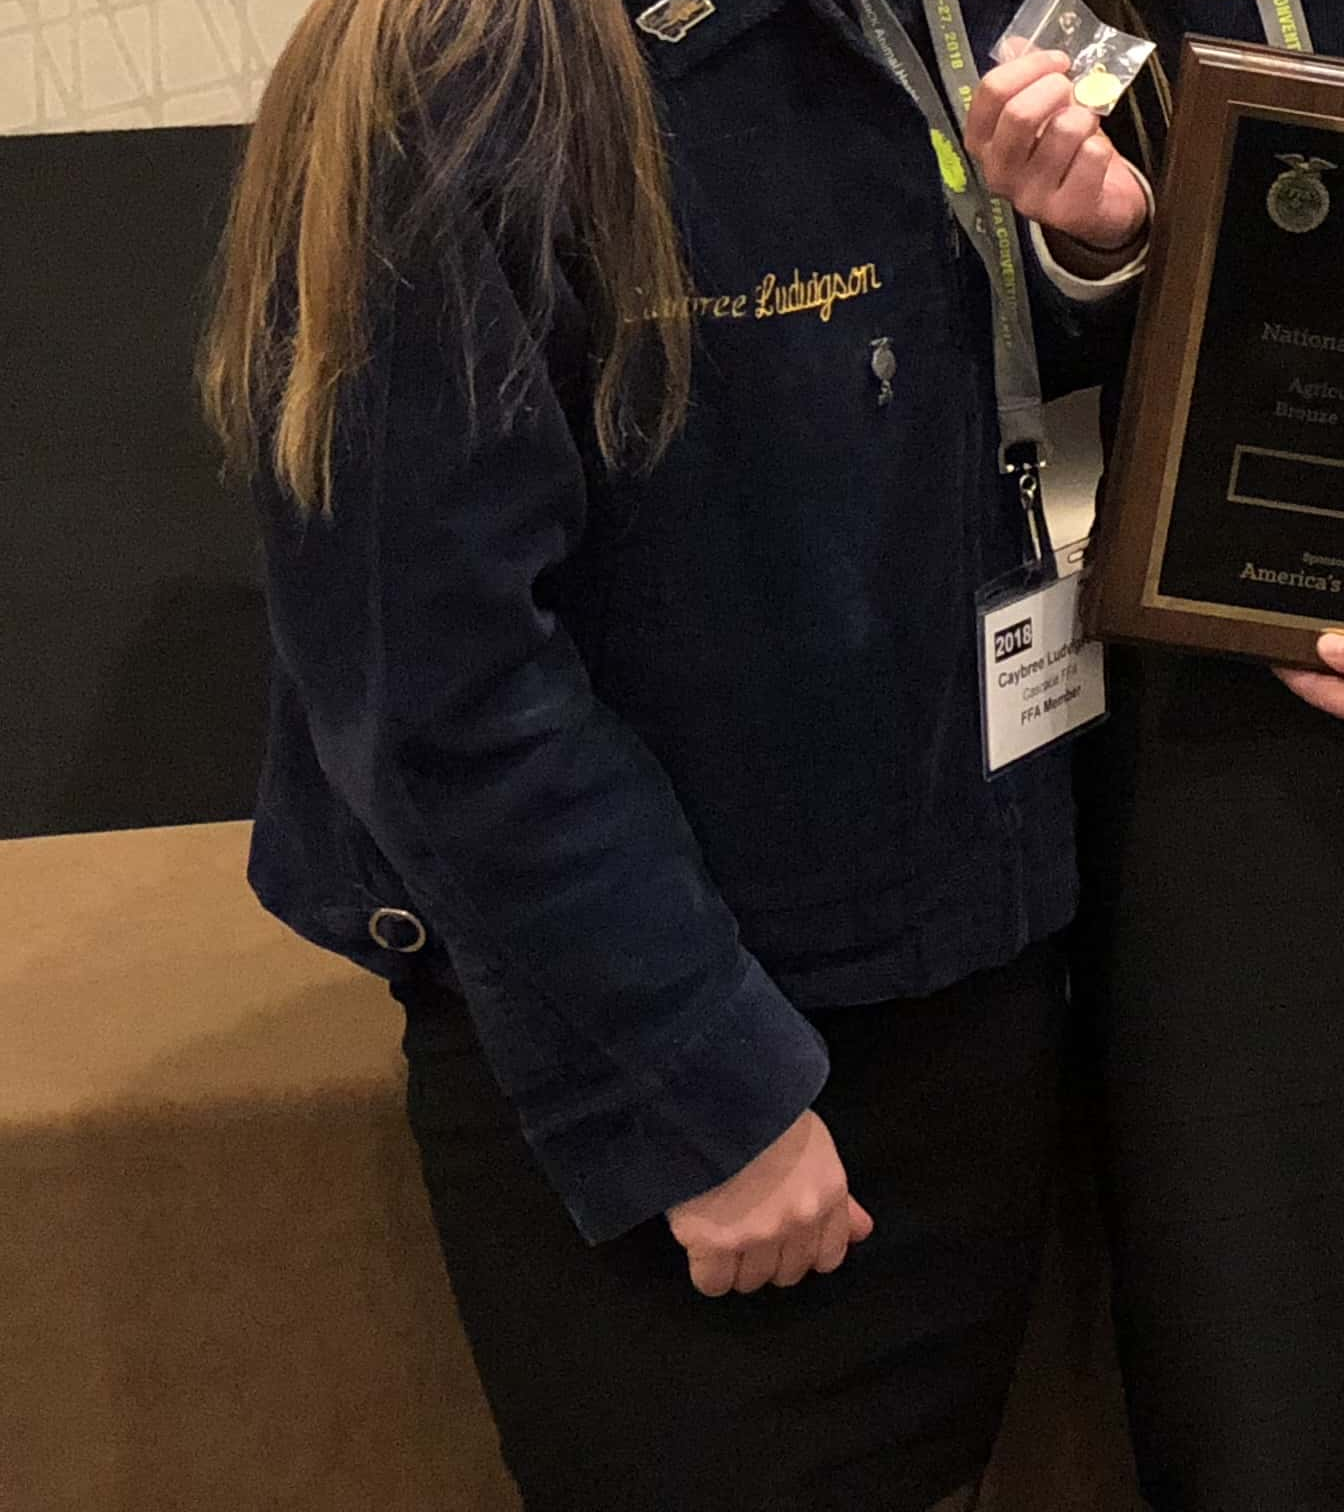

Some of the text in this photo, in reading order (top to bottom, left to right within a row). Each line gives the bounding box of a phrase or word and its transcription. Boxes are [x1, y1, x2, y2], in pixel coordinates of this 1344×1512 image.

[944, 32, 965, 70] 2018
[754, 262, 883, 323] Ludwigson
[1274, 401, 1339, 425] Bronze
[1239, 562, 1343, 593] America's
[995, 623, 1032, 657] 2018
[998, 657, 1045, 688] Caybree
[1021, 685, 1081, 726] FFA Member
